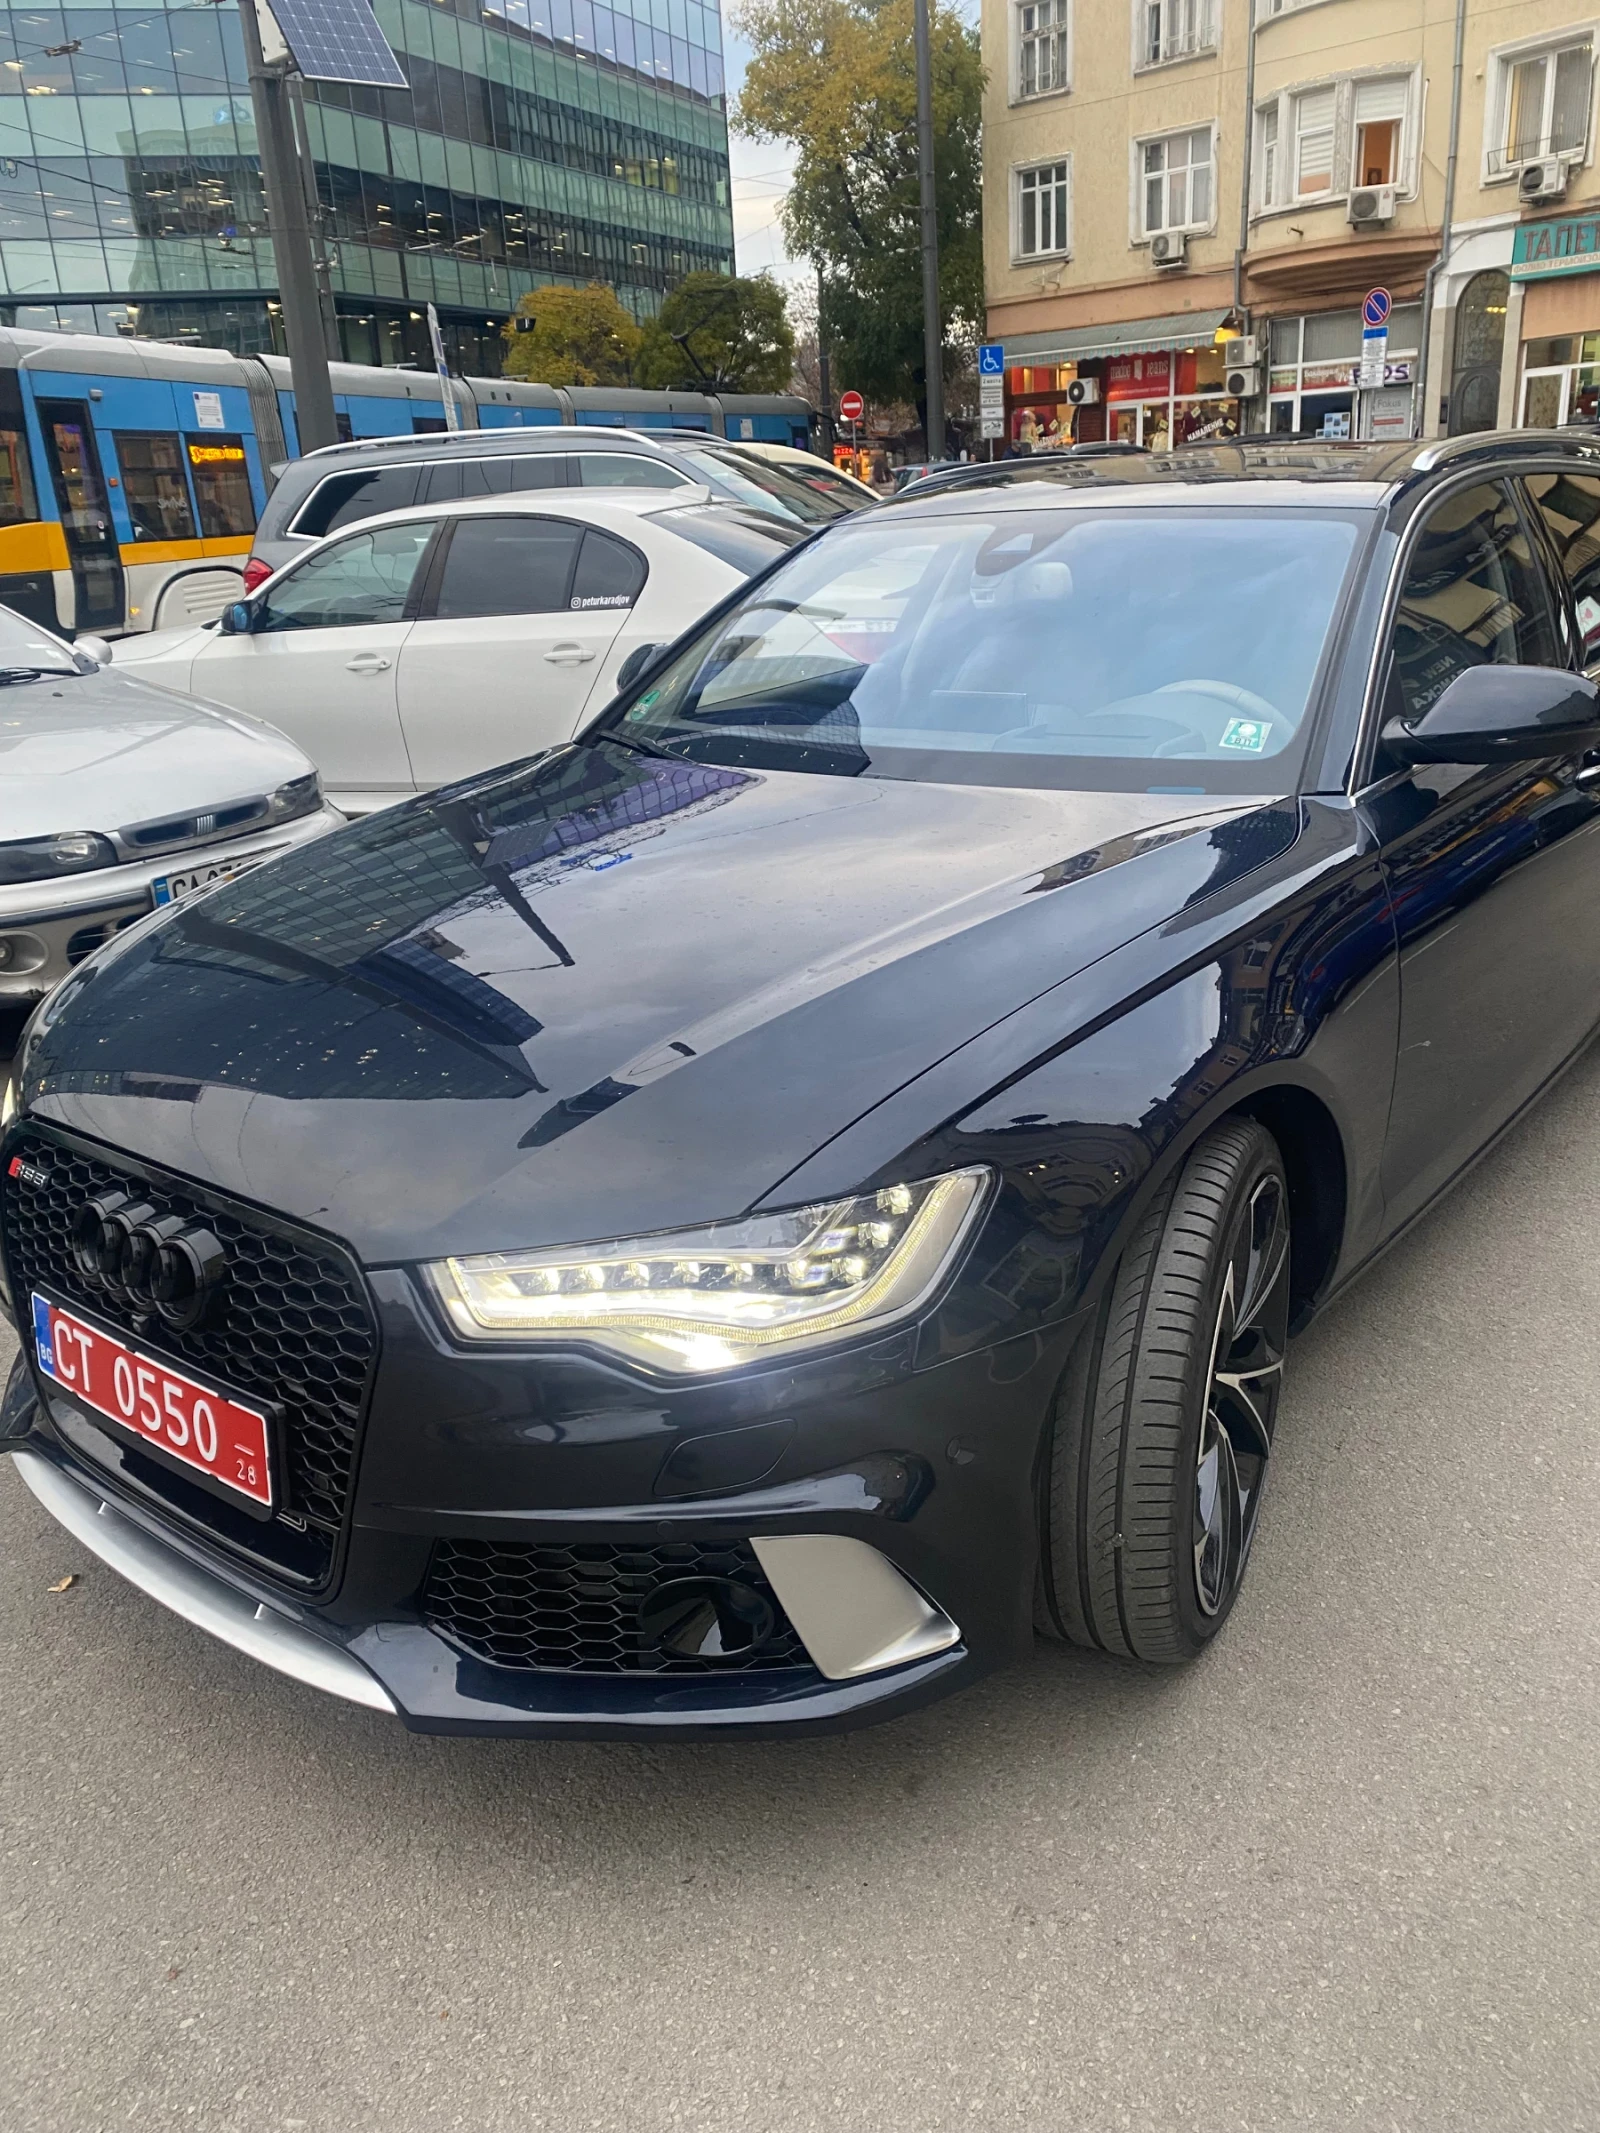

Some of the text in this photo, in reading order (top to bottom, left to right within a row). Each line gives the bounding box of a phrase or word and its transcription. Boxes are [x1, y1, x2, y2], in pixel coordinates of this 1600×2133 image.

[1549, 252, 1600, 269] ТЕРМОИЗО
[1187, 417, 1224, 442] НАМАЛЕНИЕ
[582, 594, 630, 608] peturkaradjov
[54, 1318, 217, 1463] CT 0550
[236, 1459, 257, 1486] 28
